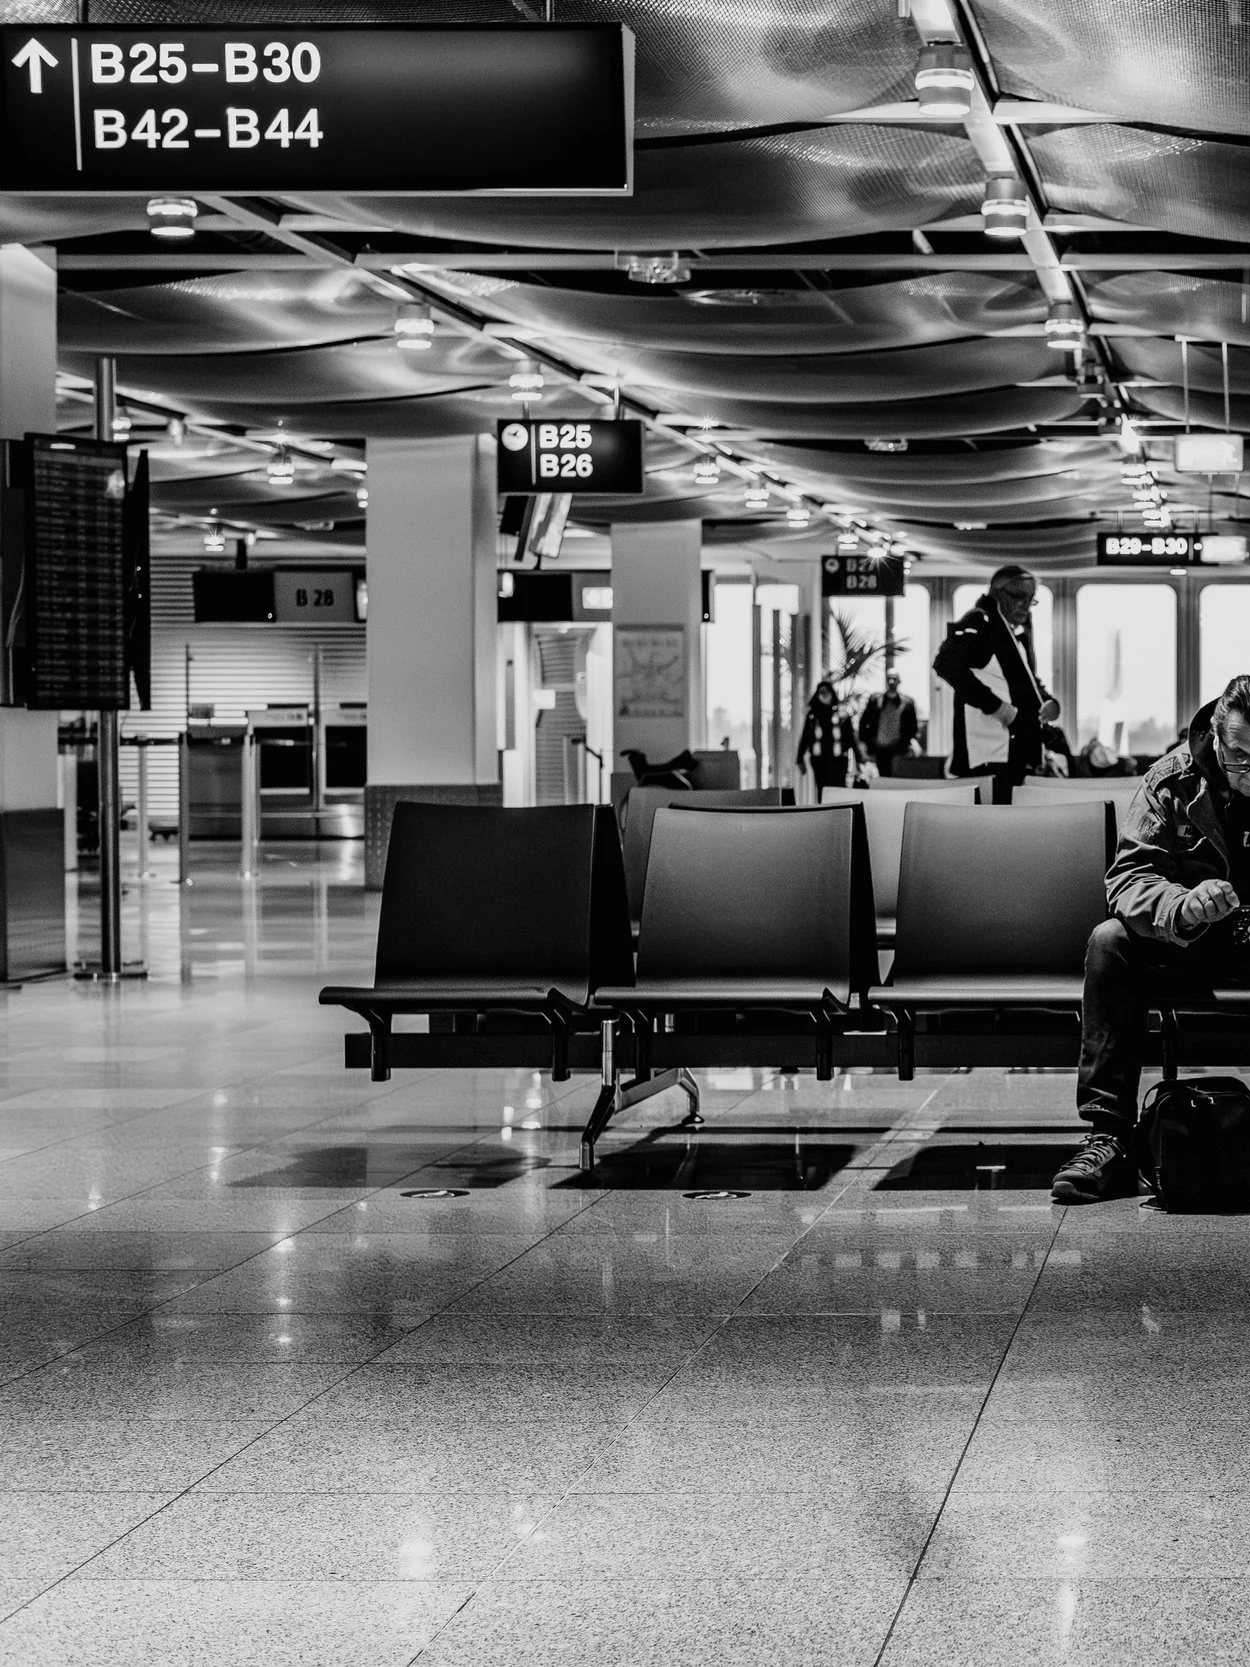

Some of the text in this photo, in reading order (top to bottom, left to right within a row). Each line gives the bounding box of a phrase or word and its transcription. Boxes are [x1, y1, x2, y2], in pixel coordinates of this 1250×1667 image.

[90, 41, 322, 85] B25-B30
[93, 107, 324, 151] B42-B44
[539, 424, 592, 449] B25
[540, 453, 593, 478] B26
[313, 588, 335, 606] 28
